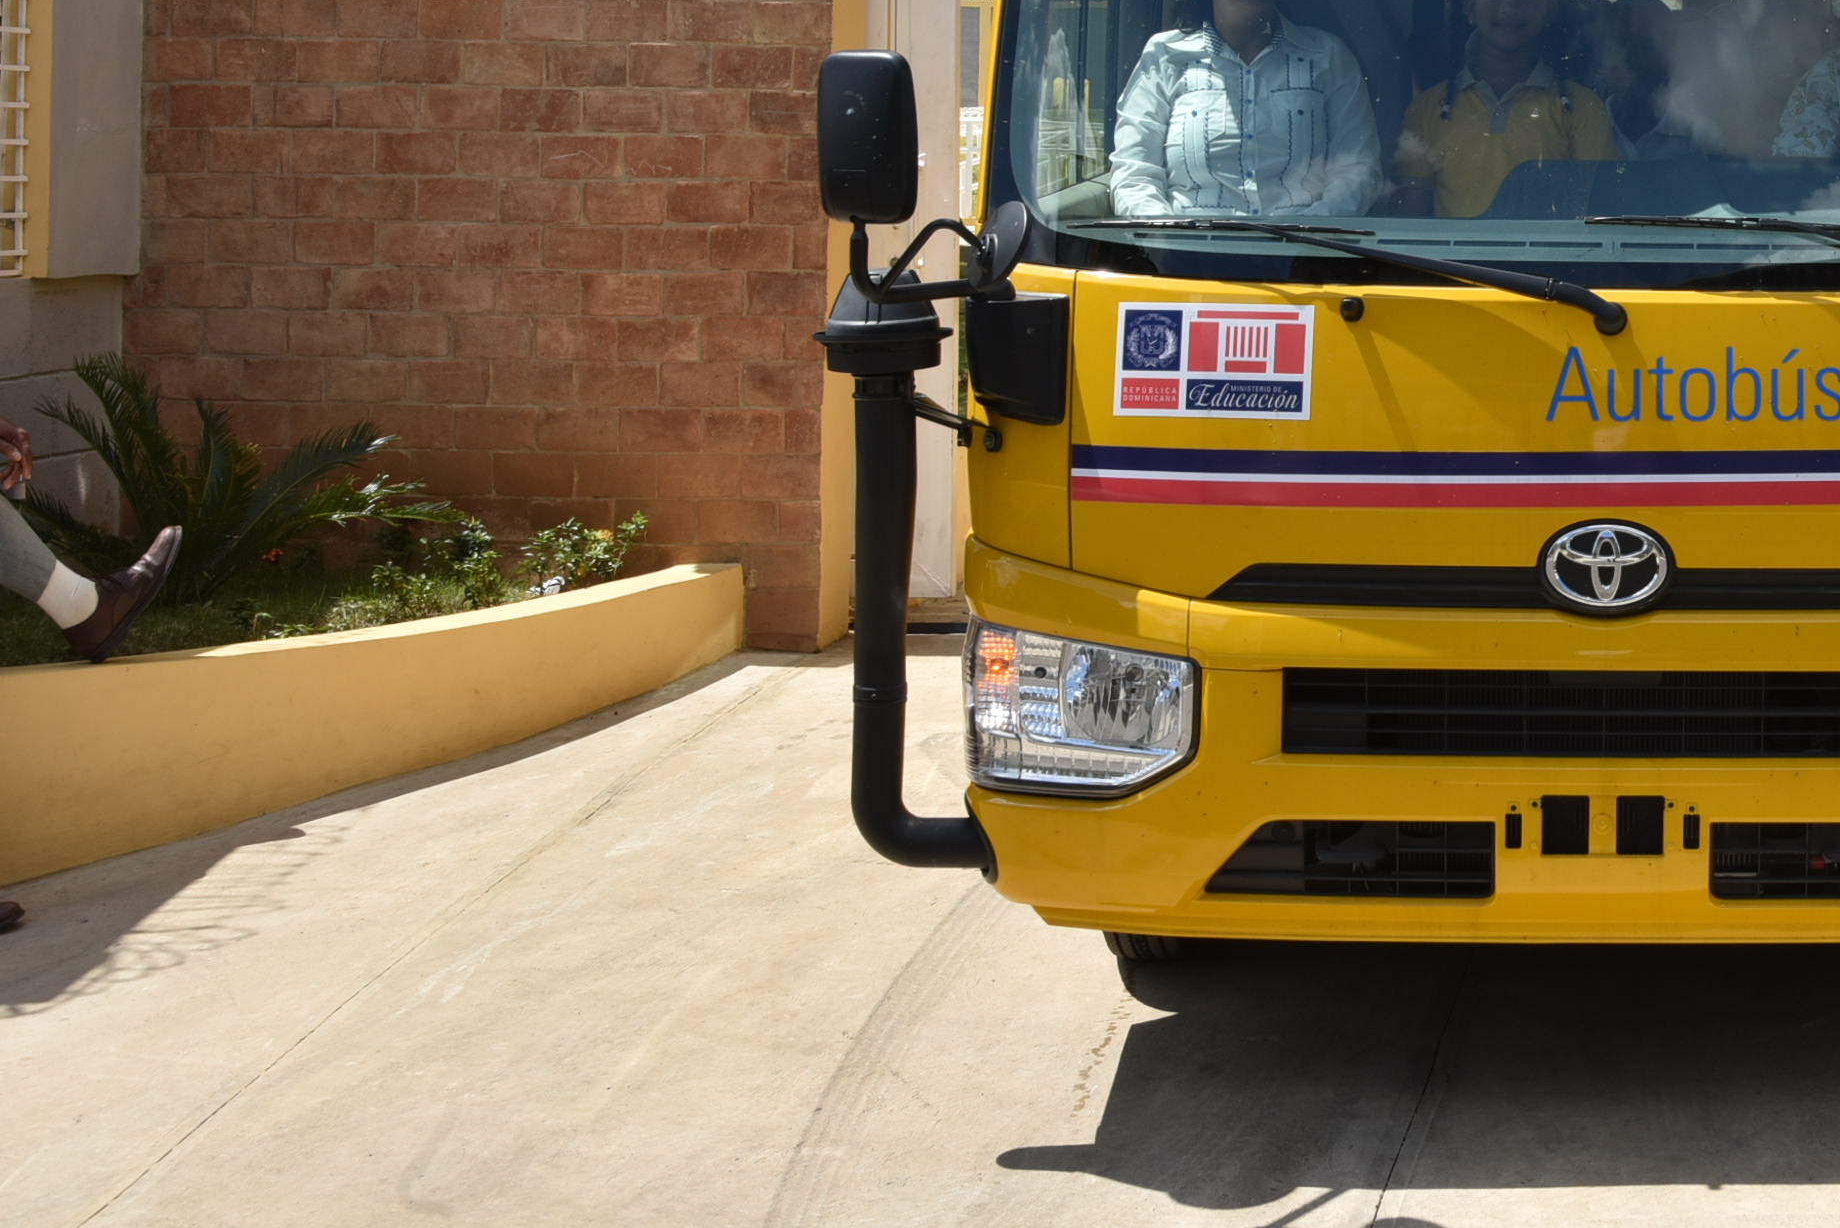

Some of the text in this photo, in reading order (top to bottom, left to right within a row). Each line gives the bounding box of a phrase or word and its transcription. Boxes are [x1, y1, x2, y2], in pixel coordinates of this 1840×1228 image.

[1123, 385, 1177, 395] REPÚBLICA
[1230, 385, 1271, 393] MINISTERIO
[1122, 394, 1177, 403] DOMINICANA
[1189, 382, 1298, 409] Educación
